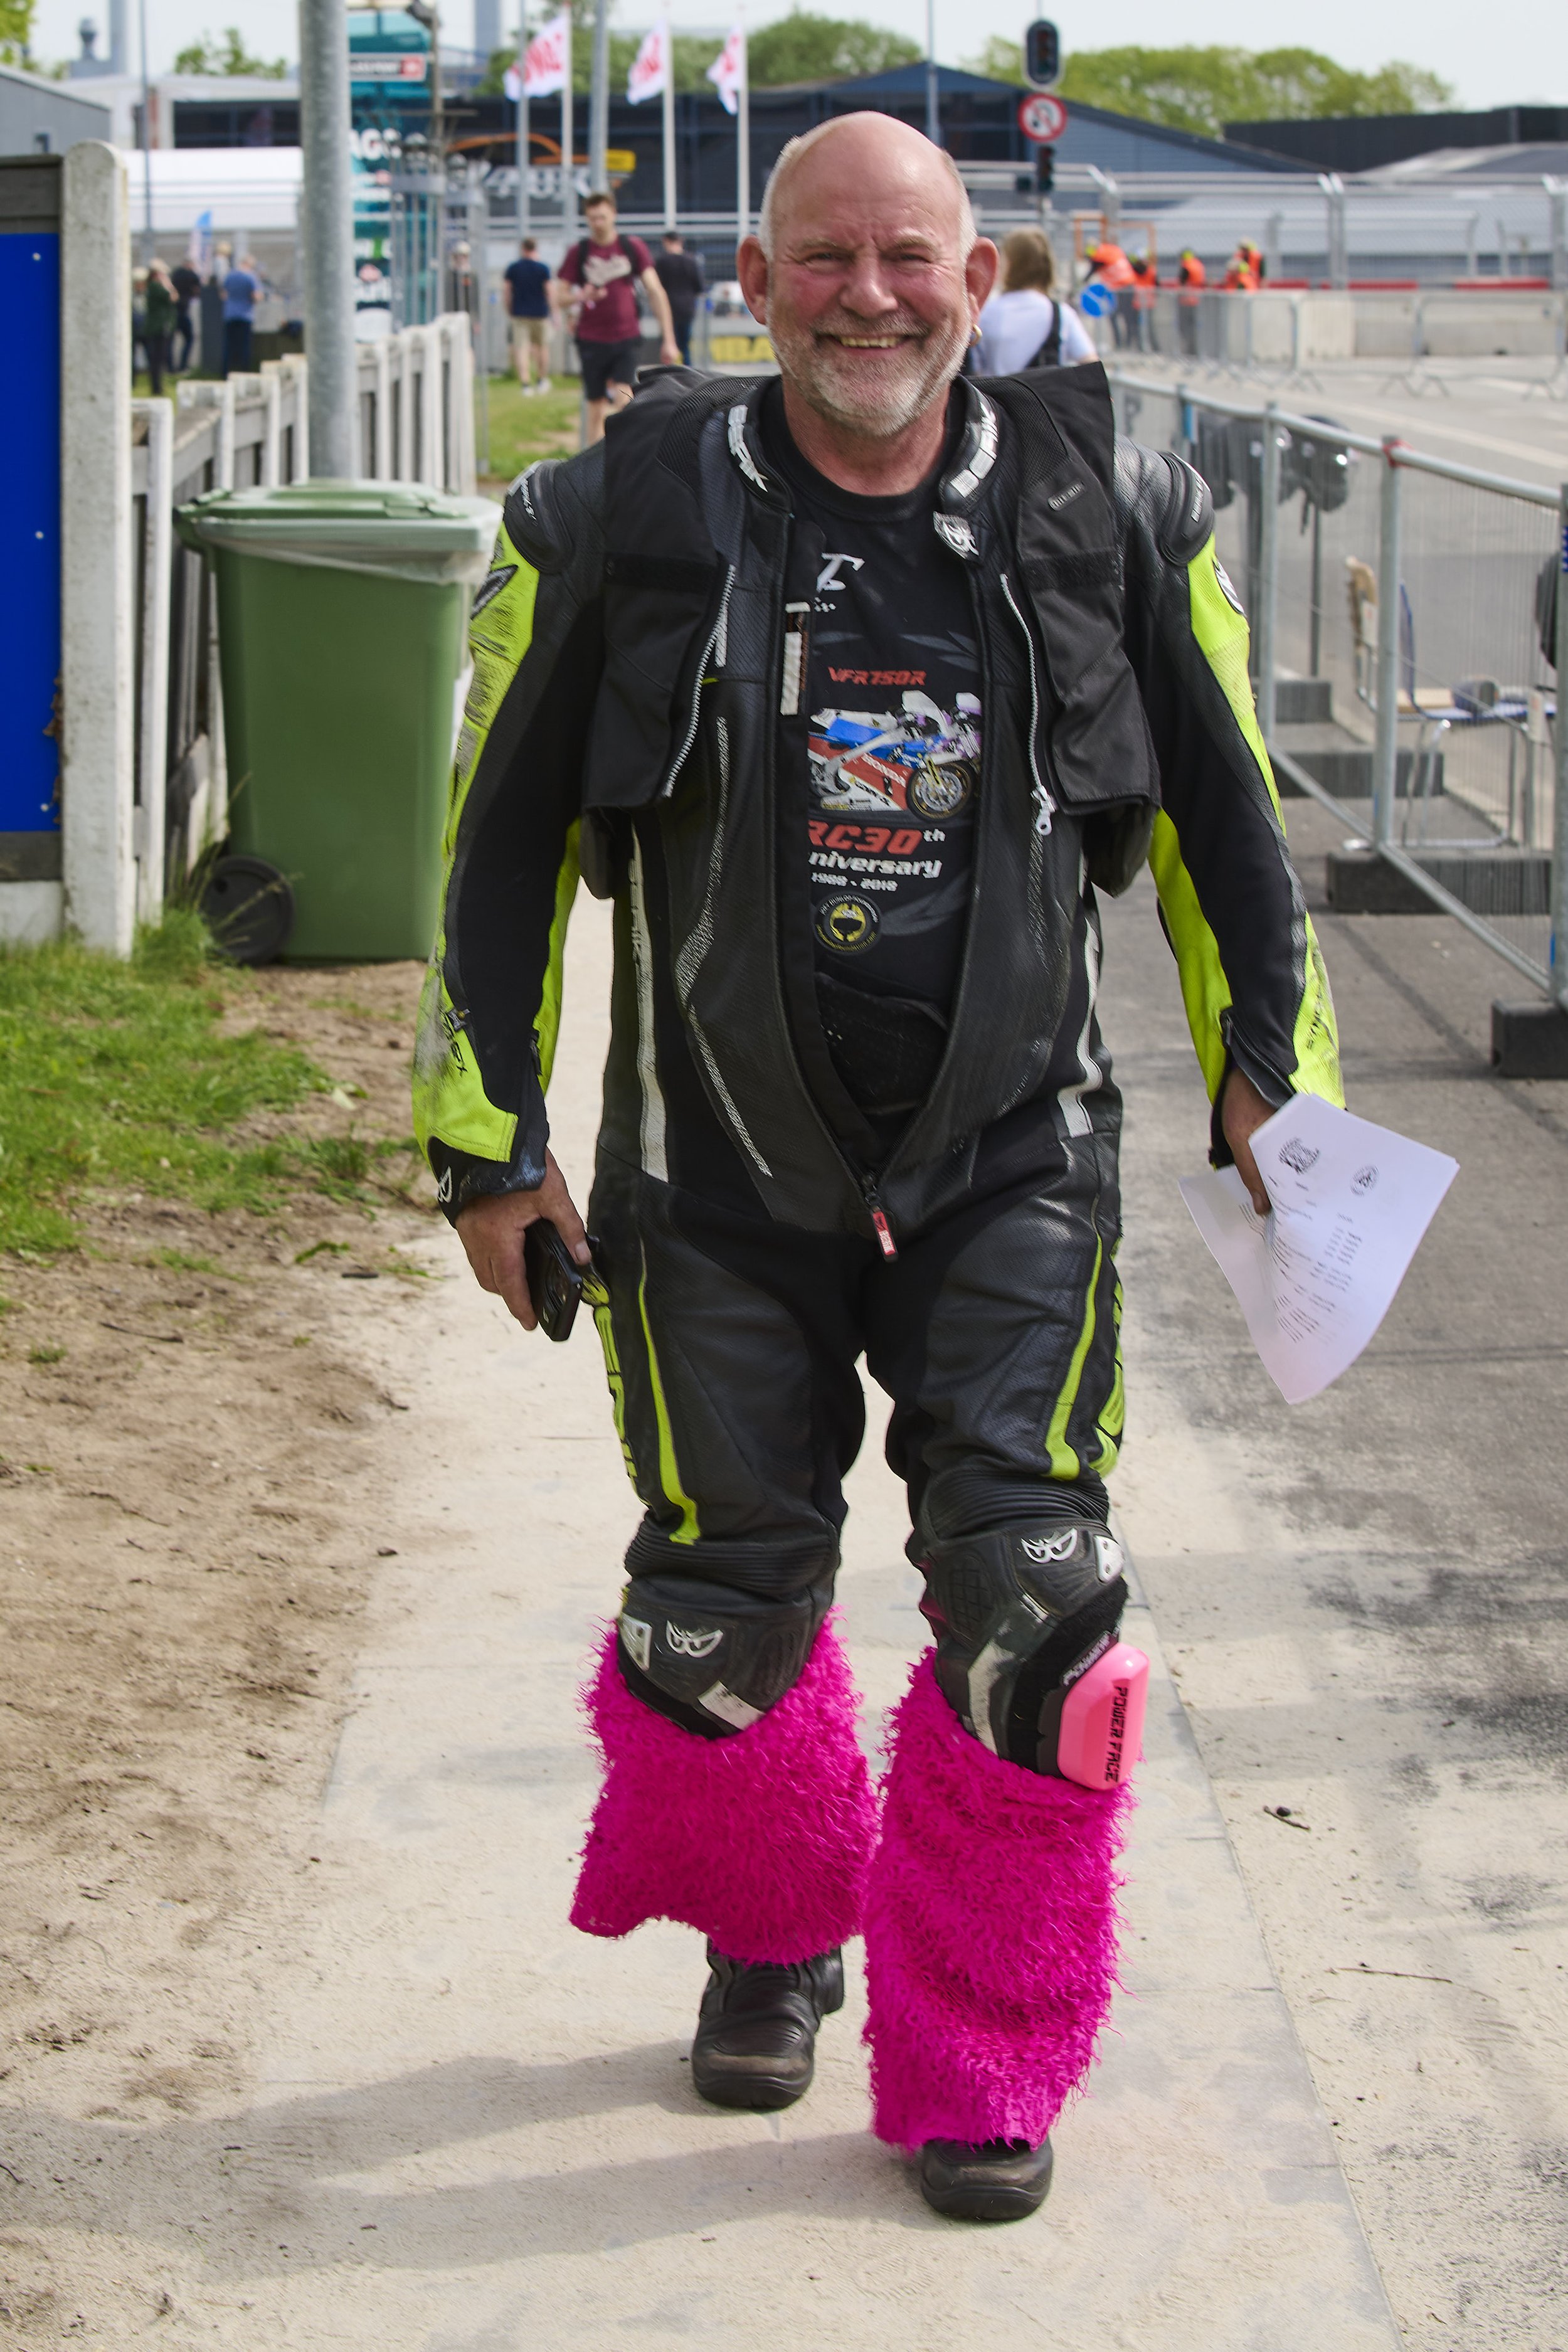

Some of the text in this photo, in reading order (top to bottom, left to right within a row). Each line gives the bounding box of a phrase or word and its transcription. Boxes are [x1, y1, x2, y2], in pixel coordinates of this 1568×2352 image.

[827, 666, 926, 686] VFR750R
[808, 820, 946, 856] RC30 th
[808, 850, 943, 879] niversary
[812, 872, 848, 887] 1988
[860, 878, 899, 892] 2018
[1104, 1685, 1128, 1783] POWER FACE
